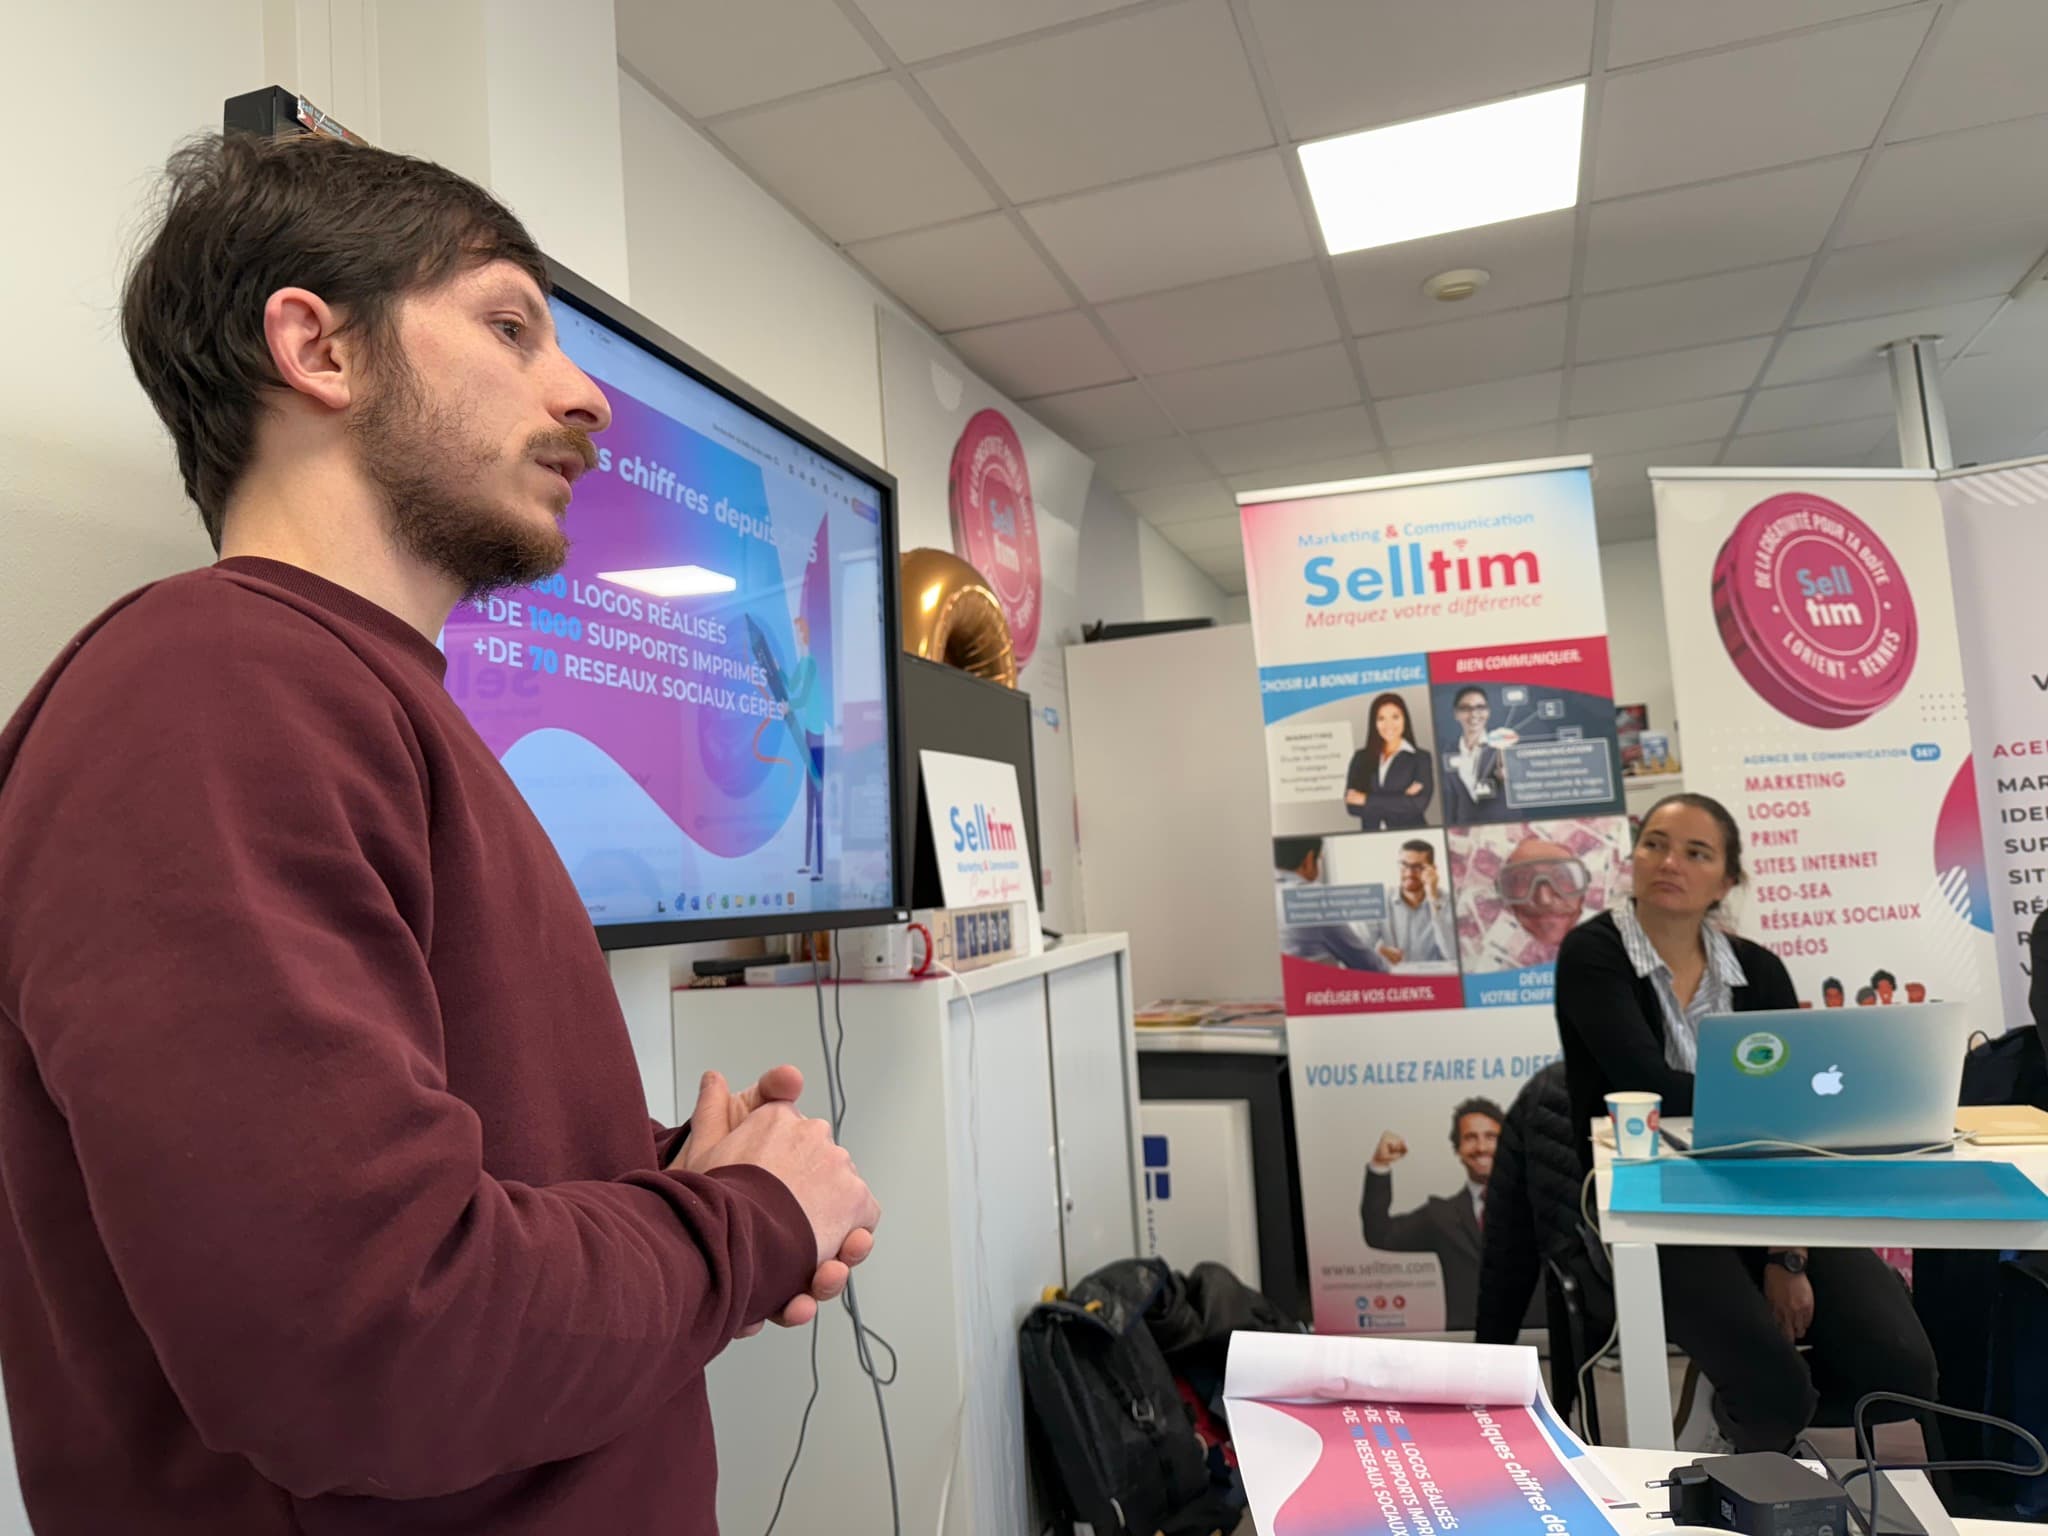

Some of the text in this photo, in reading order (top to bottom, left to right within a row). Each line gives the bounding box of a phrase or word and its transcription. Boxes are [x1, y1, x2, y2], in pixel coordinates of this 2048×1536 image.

[619, 456, 708, 514] chiffres
[715, 498, 777, 546] depuis
[1298, 512, 1535, 547] Marketing & Communication
[1845, 530, 1861, 551] TA
[1303, 539, 1541, 607] Selltim
[1796, 565, 1853, 596] Sell
[573, 579, 643, 621] LOGOS
[648, 602, 727, 645] RÉALISÉS
[1306, 592, 1544, 629] Marquez votre différence
[1805, 593, 1863, 627] tim
[527, 605, 583, 641] 1000
[588, 622, 689, 667] SUPPORTS
[693, 652, 768, 687] IMPRIMÉS
[1782, 630, 1847, 681] LORIENT
[1857, 628, 1900, 678] RENNES
[473, 636, 524, 668] +DE
[529, 645, 559, 674] 70
[564, 654, 658, 695] RESEAUX
[663, 676, 736, 711] SOCIAUX
[1304, 676, 1318, 689] LA
[1320, 671, 1358, 687] BONNE
[1456, 658, 1483, 673] BIEN
[1992, 739, 2048, 759] AGE
[1745, 771, 1846, 792] MARKETING
[1747, 800, 1811, 820] LOGOS
[949, 803, 1017, 852] Selltim
[1751, 828, 1799, 847] PRINT
[1754, 851, 1878, 875] SITES INTERNET
[1757, 882, 1832, 903] SEO-SEA
[1760, 904, 1921, 930] RÉSEAUX SOCIAUX
[1305, 1064, 1357, 1087] VOUS
[1362, 1060, 1417, 1084] ALLEZ
[1422, 1058, 1476, 1082] FAIRE
[1482, 1056, 1505, 1079] LA
[1354, 1439, 1387, 1489] RESEAUX
[1374, 1490, 1410, 1536] SOCIAUX
[1381, 1449, 1419, 1506] SUPPORTS
[1401, 1442, 1431, 1480] LOGOS
[1419, 1481, 1460, 1530] RÉALISÉS
[1505, 1462, 1551, 1511] chiffres
